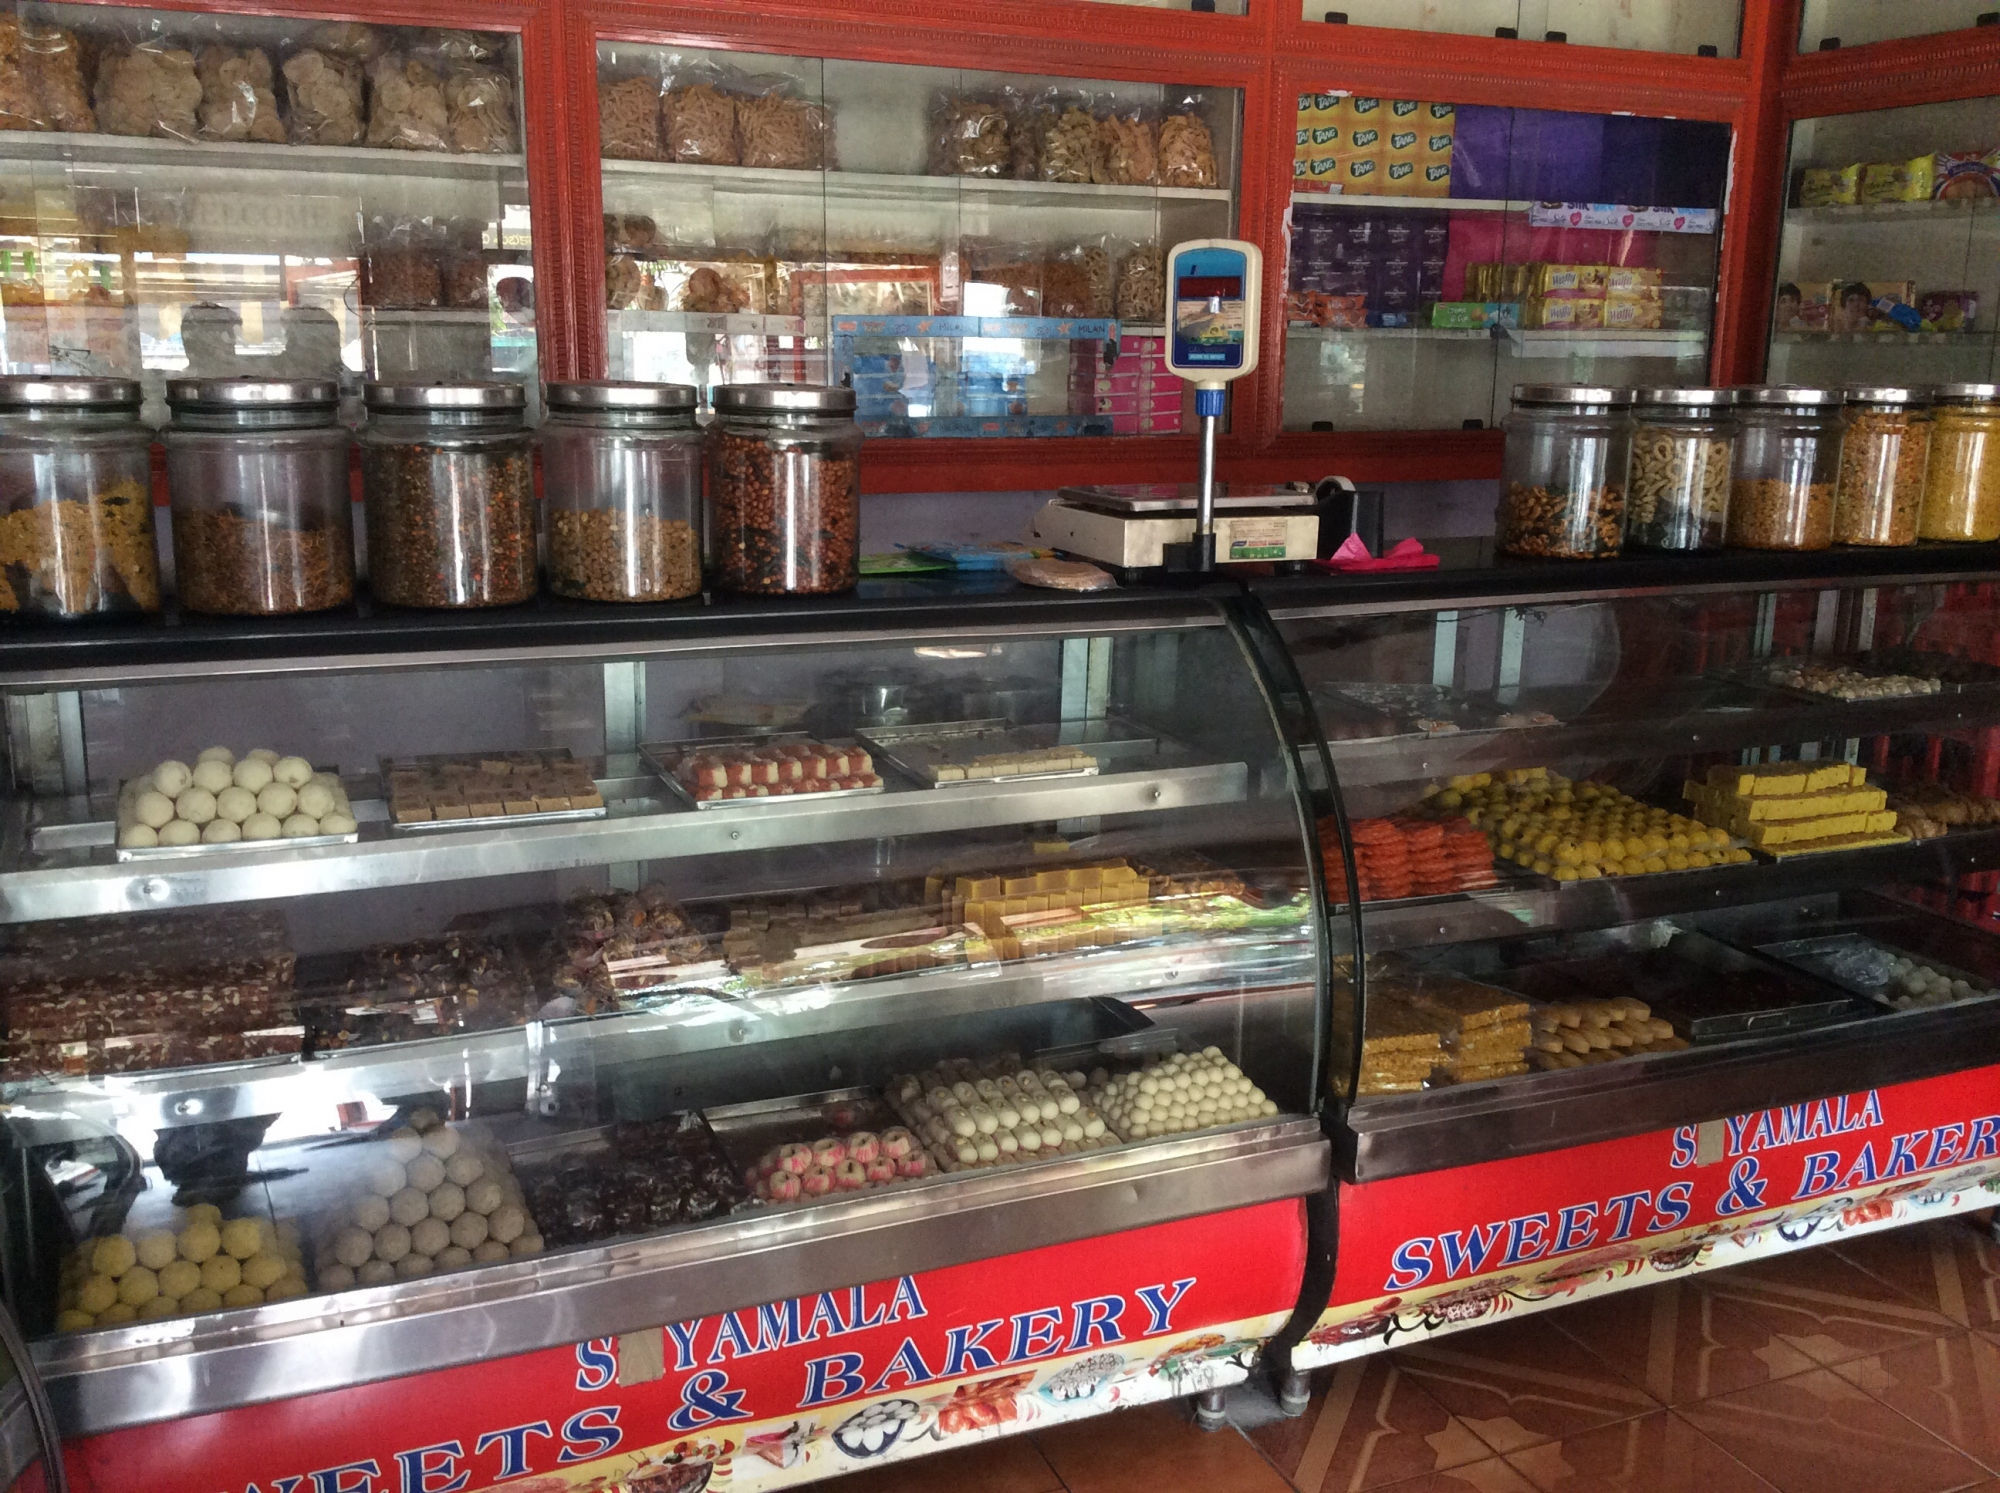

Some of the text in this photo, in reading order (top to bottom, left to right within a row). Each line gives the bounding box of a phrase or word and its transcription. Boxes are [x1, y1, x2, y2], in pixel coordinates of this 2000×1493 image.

[1357, 100, 1378, 113] TANG
[1396, 102, 1417, 116] TANG
[1315, 128, 1336, 143] TANG
[1355, 130, 1376, 146] TANG
[1394, 133, 1415, 148] TANG
[1432, 136, 1451, 150] TANG
[1314, 159, 1335, 174] TANG
[1353, 161, 1375, 176] TANG
[1392, 163, 1412, 179] TANG
[1428, 166, 1449, 181] TANG
[1670, 1089, 1883, 1168] SYAMALA
[1383, 1114, 2000, 1291] SWEETS & BAKER
[575, 1275, 928, 1391] SYAMALA
[668, 1369, 754, 1431] &
[796, 1277, 1197, 1408] BAKERY
